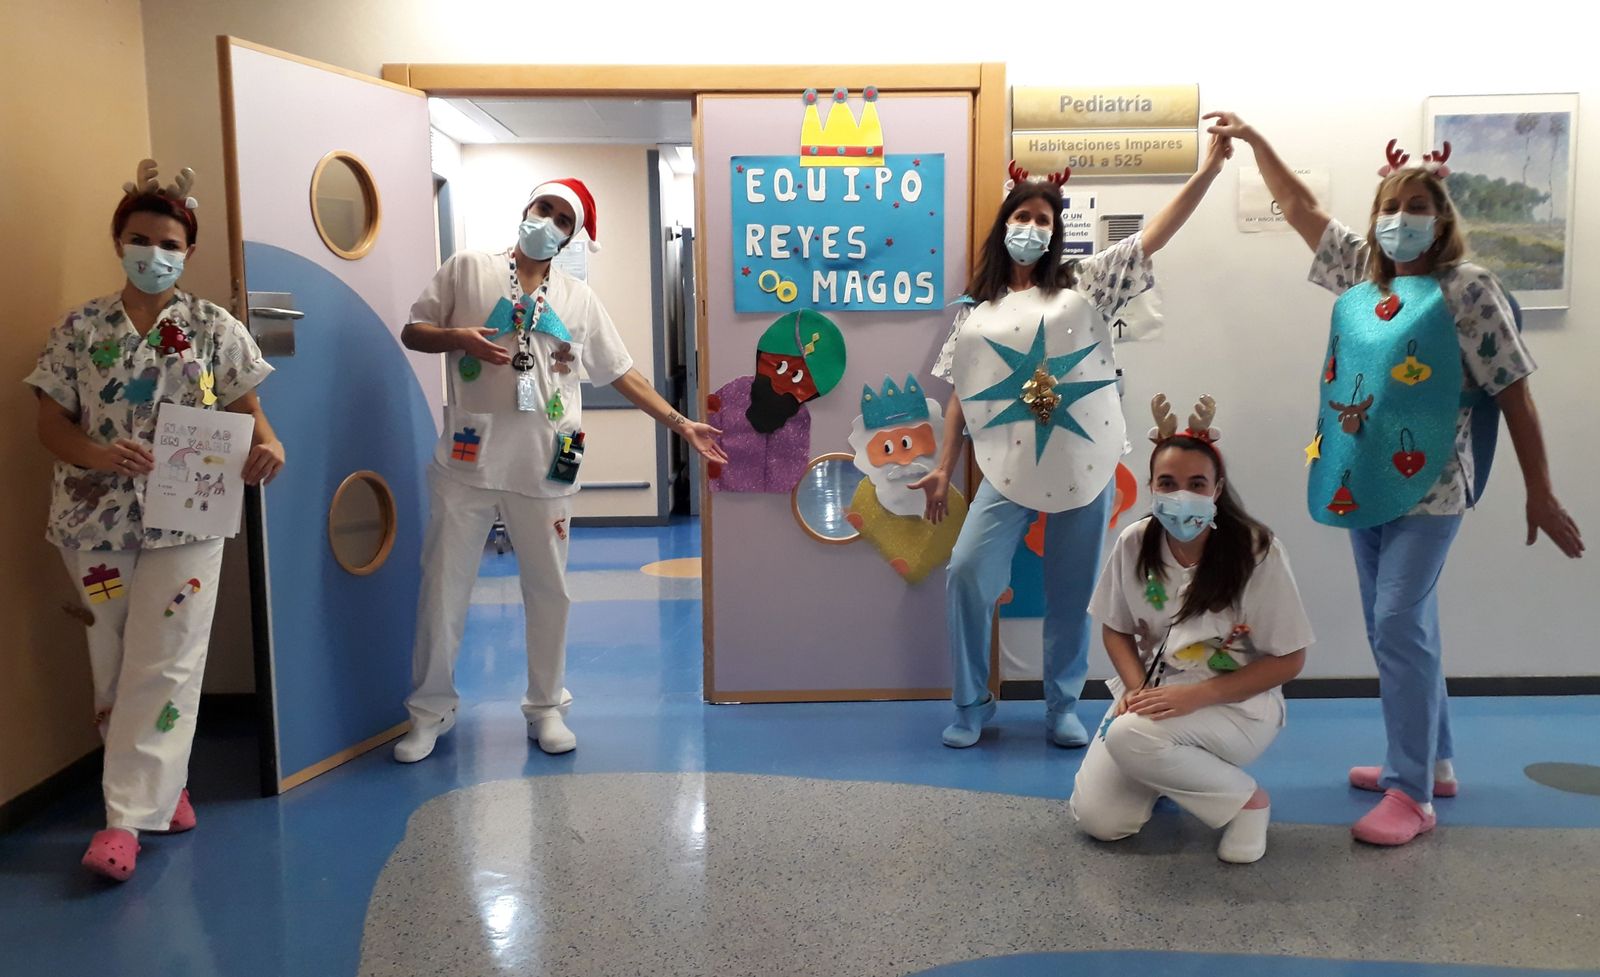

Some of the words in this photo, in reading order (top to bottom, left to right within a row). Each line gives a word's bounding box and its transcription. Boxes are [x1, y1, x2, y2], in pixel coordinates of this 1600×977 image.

[1060, 95, 1152, 112] Pediatría
[1029, 139, 1121, 152] Habitaciones
[1125, 137, 1183, 152] Impares
[1068, 155, 1095, 168] 501
[1101, 158, 1110, 167] a
[1114, 154, 1143, 167] 525
[746, 167, 922, 203] EQUIPO
[746, 224, 867, 259] REYES
[812, 270, 934, 304] MAGOS
